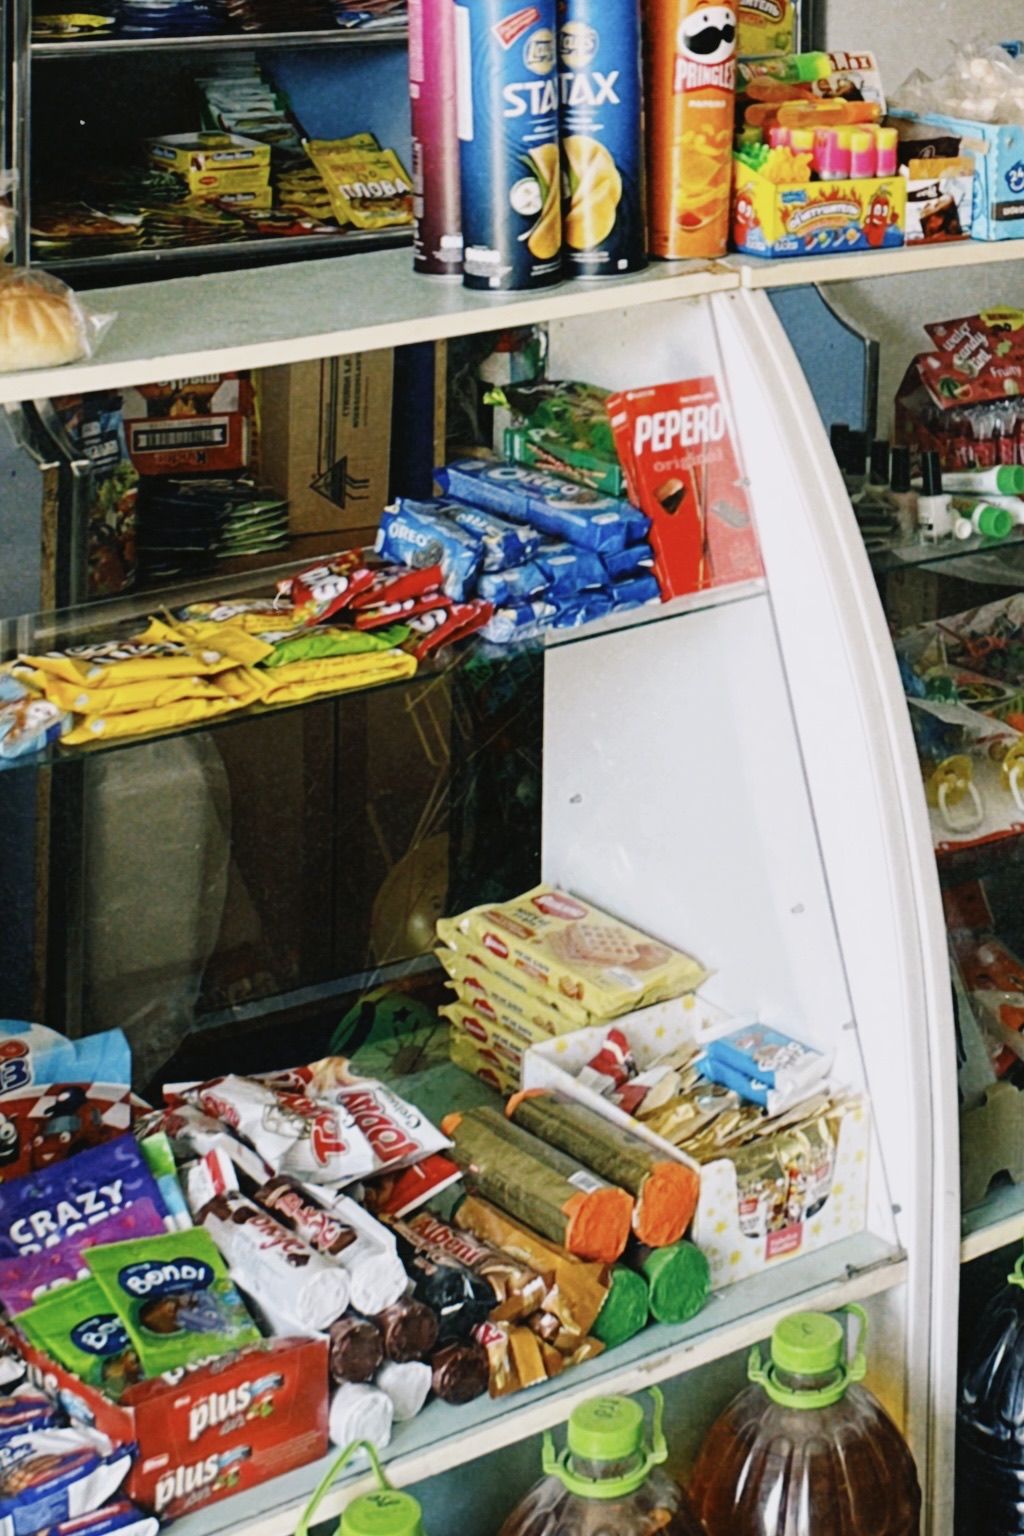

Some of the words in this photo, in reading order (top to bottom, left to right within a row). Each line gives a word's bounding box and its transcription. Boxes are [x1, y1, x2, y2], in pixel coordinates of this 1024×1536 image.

[502, 80, 556, 118] STA
[560, 70, 620, 107] TAX
[953, 331, 989, 365] candy
[990, 365, 1022, 378] Fruity
[634, 401, 727, 457] PEPERO
[387, 522, 430, 547] OREO
[9, 1178, 124, 1246] CRAZY
[411, 1217, 485, 1263] Albeni
[189, 1379, 252, 1442] plus
[154, 1453, 221, 1512] plus
